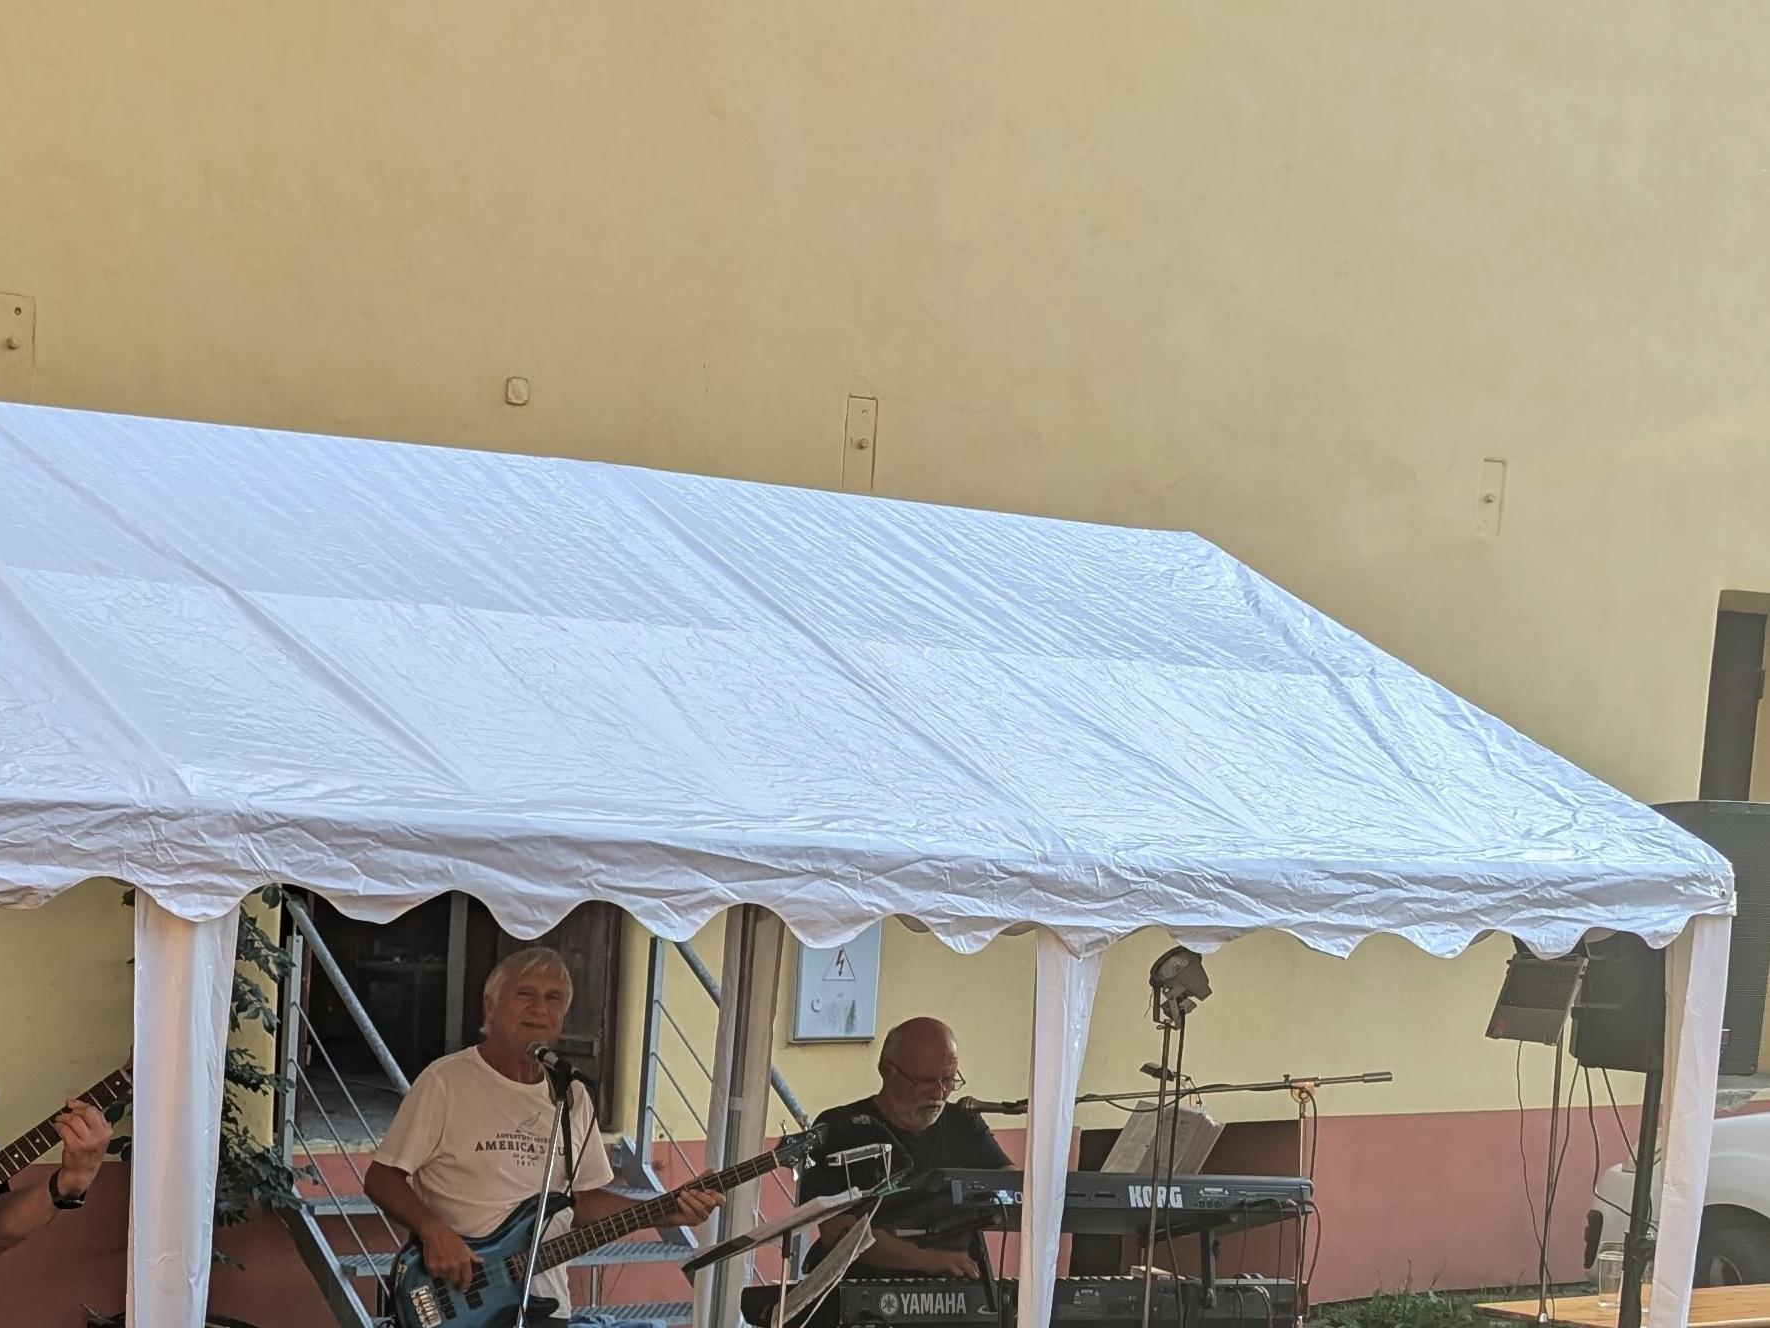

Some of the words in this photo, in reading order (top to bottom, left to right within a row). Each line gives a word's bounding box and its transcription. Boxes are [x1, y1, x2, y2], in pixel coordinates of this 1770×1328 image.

[474, 1140, 546, 1154] AMERICA'S
[1128, 1185, 1183, 1209] KORG
[900, 1292, 967, 1314] YAMAHA
